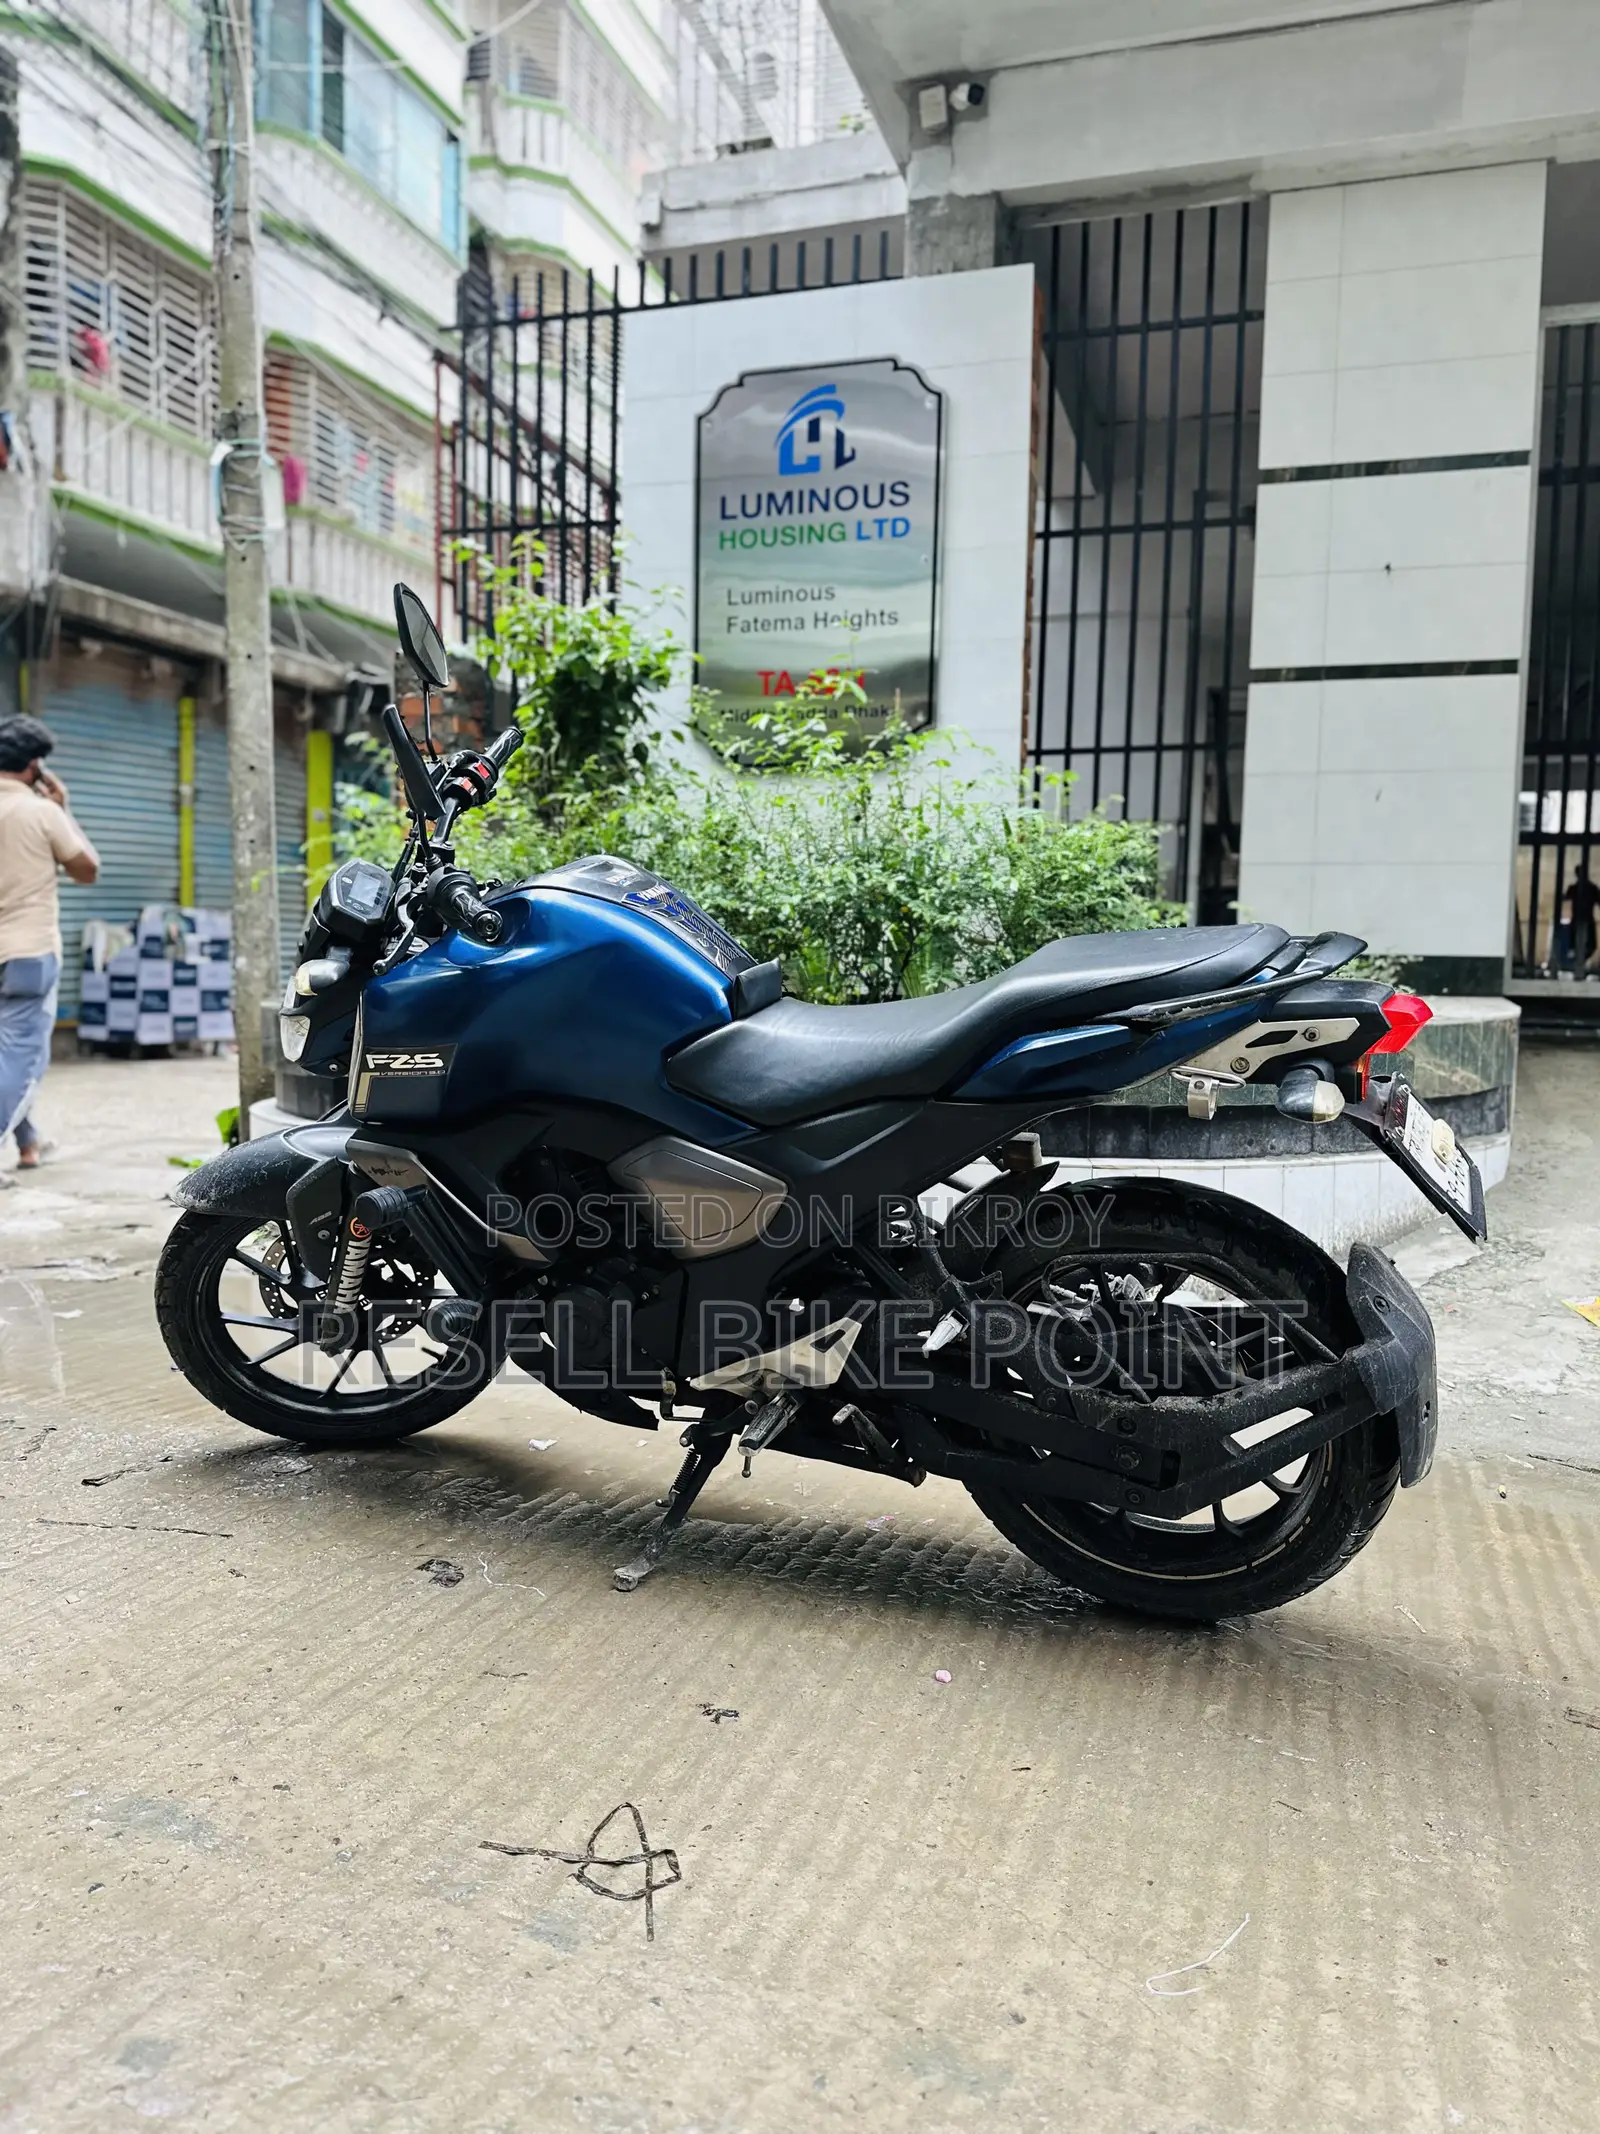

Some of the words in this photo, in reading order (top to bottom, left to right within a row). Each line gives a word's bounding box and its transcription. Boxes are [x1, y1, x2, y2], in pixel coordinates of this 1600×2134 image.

[719, 480, 911, 521] LUMINOUS
[718, 521, 847, 551] HOUSING
[856, 516, 911, 542] LTD
[726, 584, 836, 607] Luminous
[726, 615, 806, 635] Fatema
[813, 608, 899, 633] Heights
[332, 1236, 373, 1315] YAMAHA
